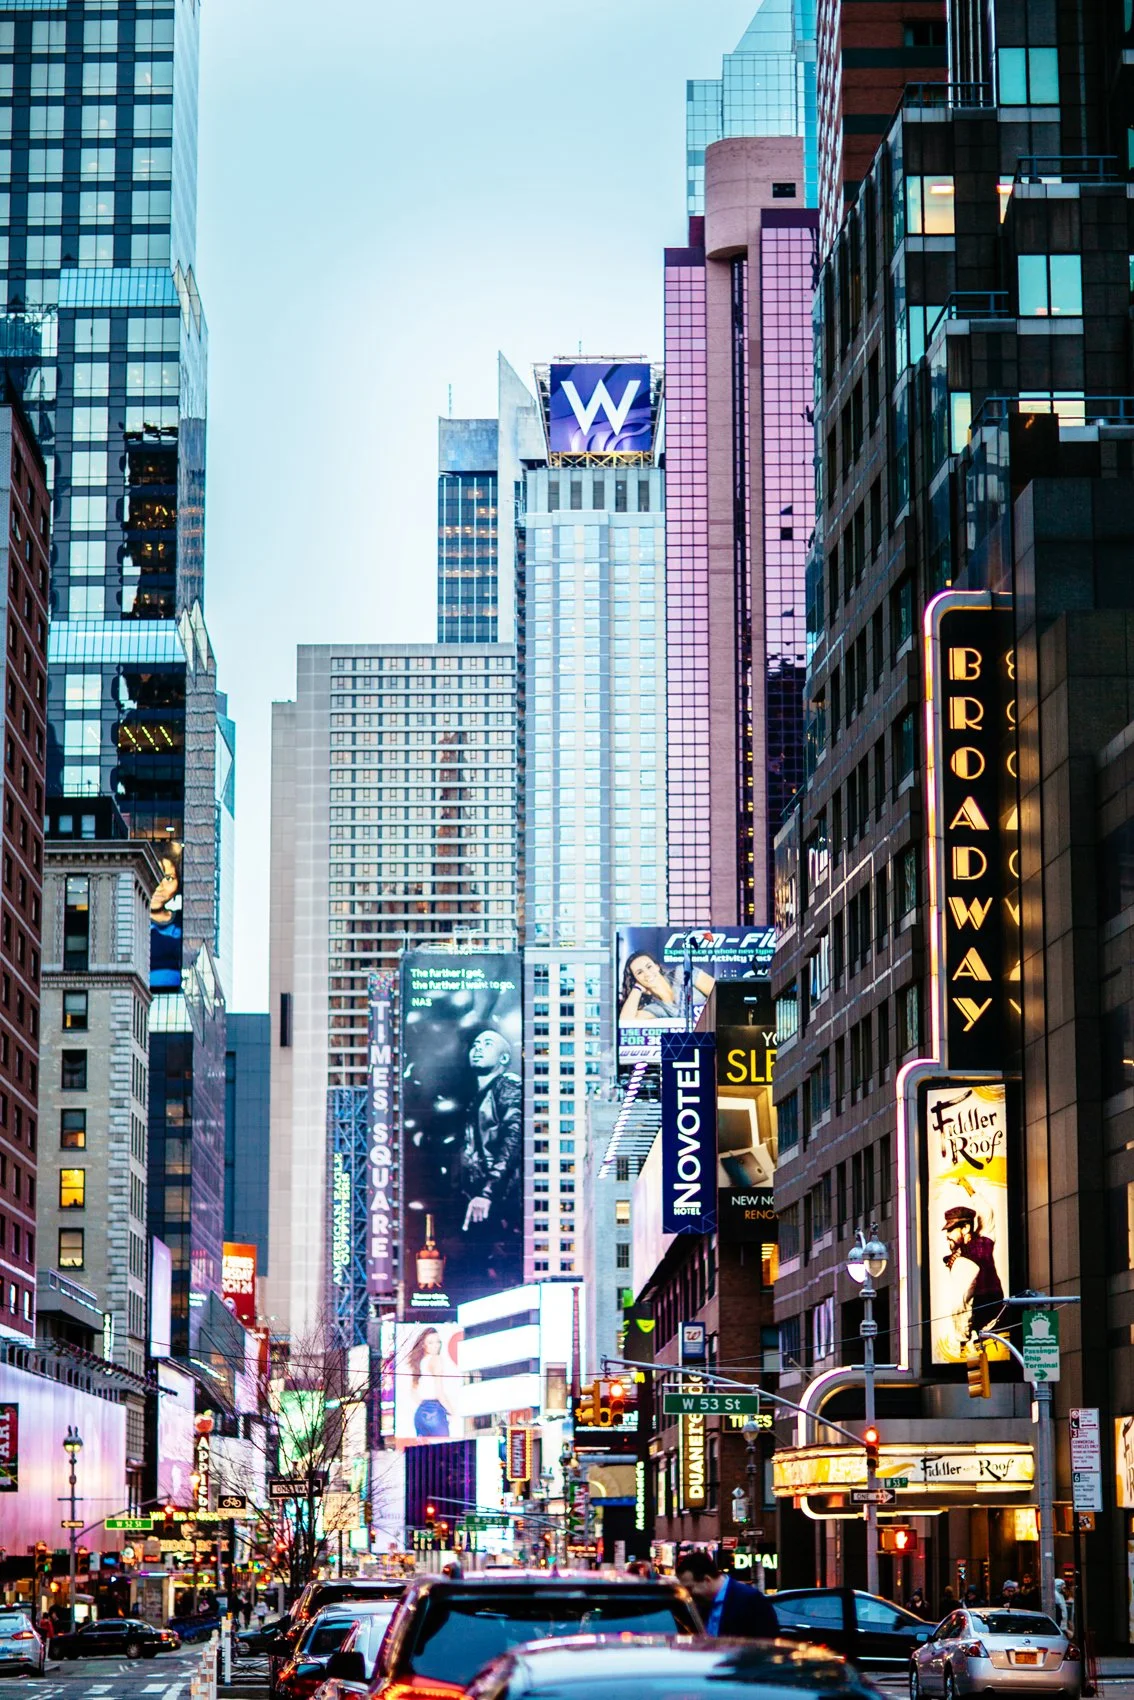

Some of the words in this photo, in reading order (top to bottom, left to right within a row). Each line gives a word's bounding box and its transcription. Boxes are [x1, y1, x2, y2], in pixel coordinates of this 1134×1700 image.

[560, 379, 641, 436] W
[949, 647, 993, 1032] BROADWAY
[710, 955, 747, 963] Activity
[410, 968, 428, 978] The
[429, 968, 460, 978] further
[412, 981, 428, 990] the
[429, 981, 460, 990] further
[466, 981, 488, 990] want
[412, 998, 432, 1007] NAS
[620, 1037, 645, 1045] FOR
[371, 1001, 391, 1110] TIMES
[930, 1090, 997, 1148] Fiddler
[673, 1049, 701, 1207] NOVOTEL
[947, 1130, 1003, 1170] Roof
[370, 1123, 392, 1258] SQUARE
[731, 1196, 758, 1205] NEW
[674, 1207, 701, 1216] HOTEL
[333, 1204, 343, 1285] AMERICAN
[241, 1281, 253, 1294] 24
[682, 1399, 694, 1410] W
[700, 1399, 719, 1410] 53
[724, 1399, 741, 1410] St
[920, 1455, 961, 1481] Fiddler
[979, 1459, 1014, 1481] Roof
[893, 1479, 900, 1487] 53
[116, 1520, 123, 1528] W
[124, 1520, 133, 1528] 52
[135, 1520, 142, 1528] St
